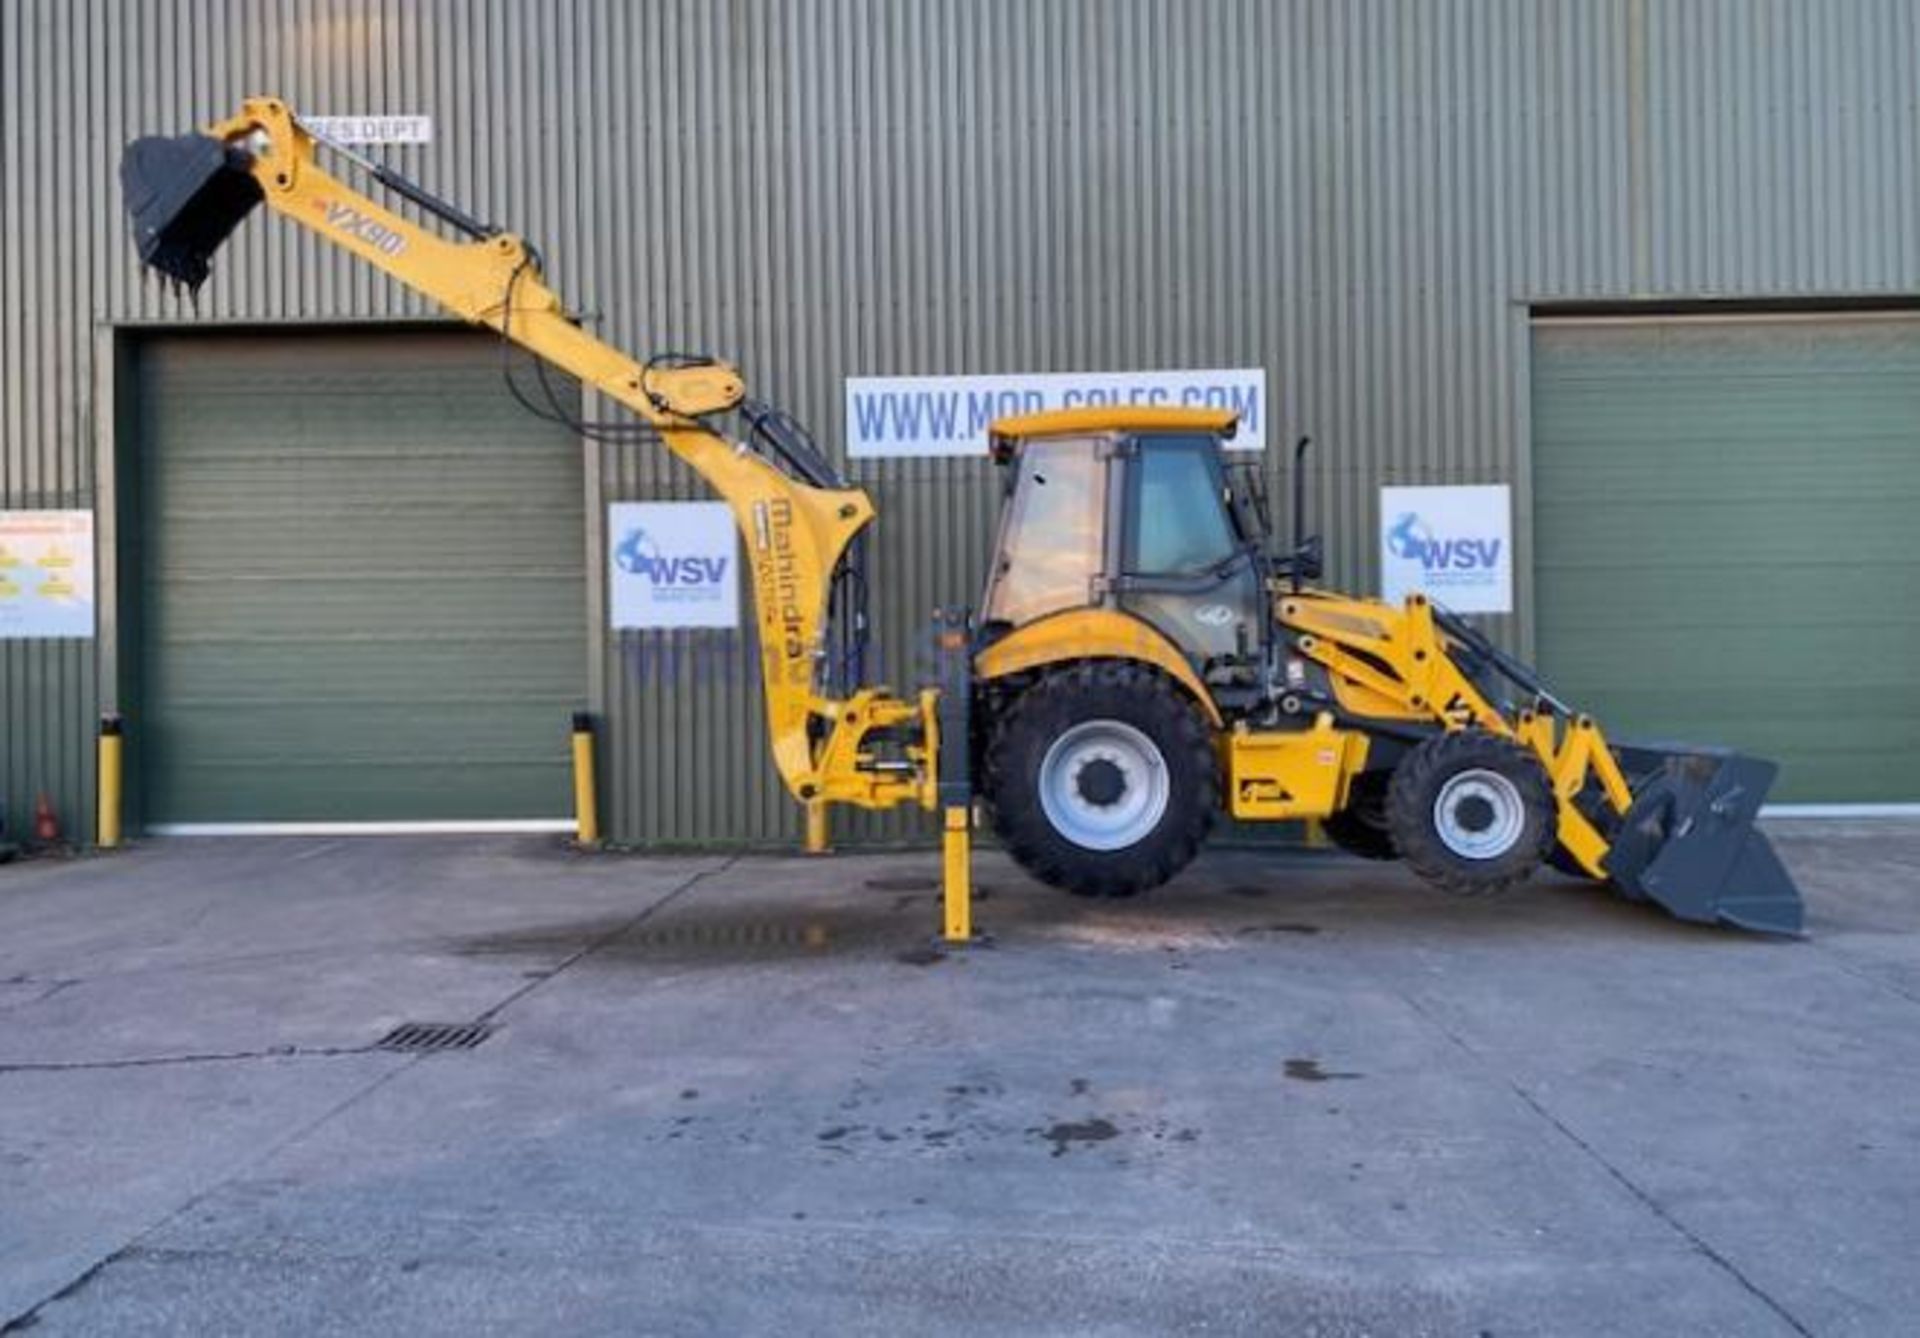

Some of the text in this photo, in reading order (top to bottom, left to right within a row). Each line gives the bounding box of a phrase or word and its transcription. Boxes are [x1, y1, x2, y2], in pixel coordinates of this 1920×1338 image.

[362, 119, 422, 139] DEPT
[1418, 538, 1501, 569] WSV
[647, 557, 727, 585] WSV
